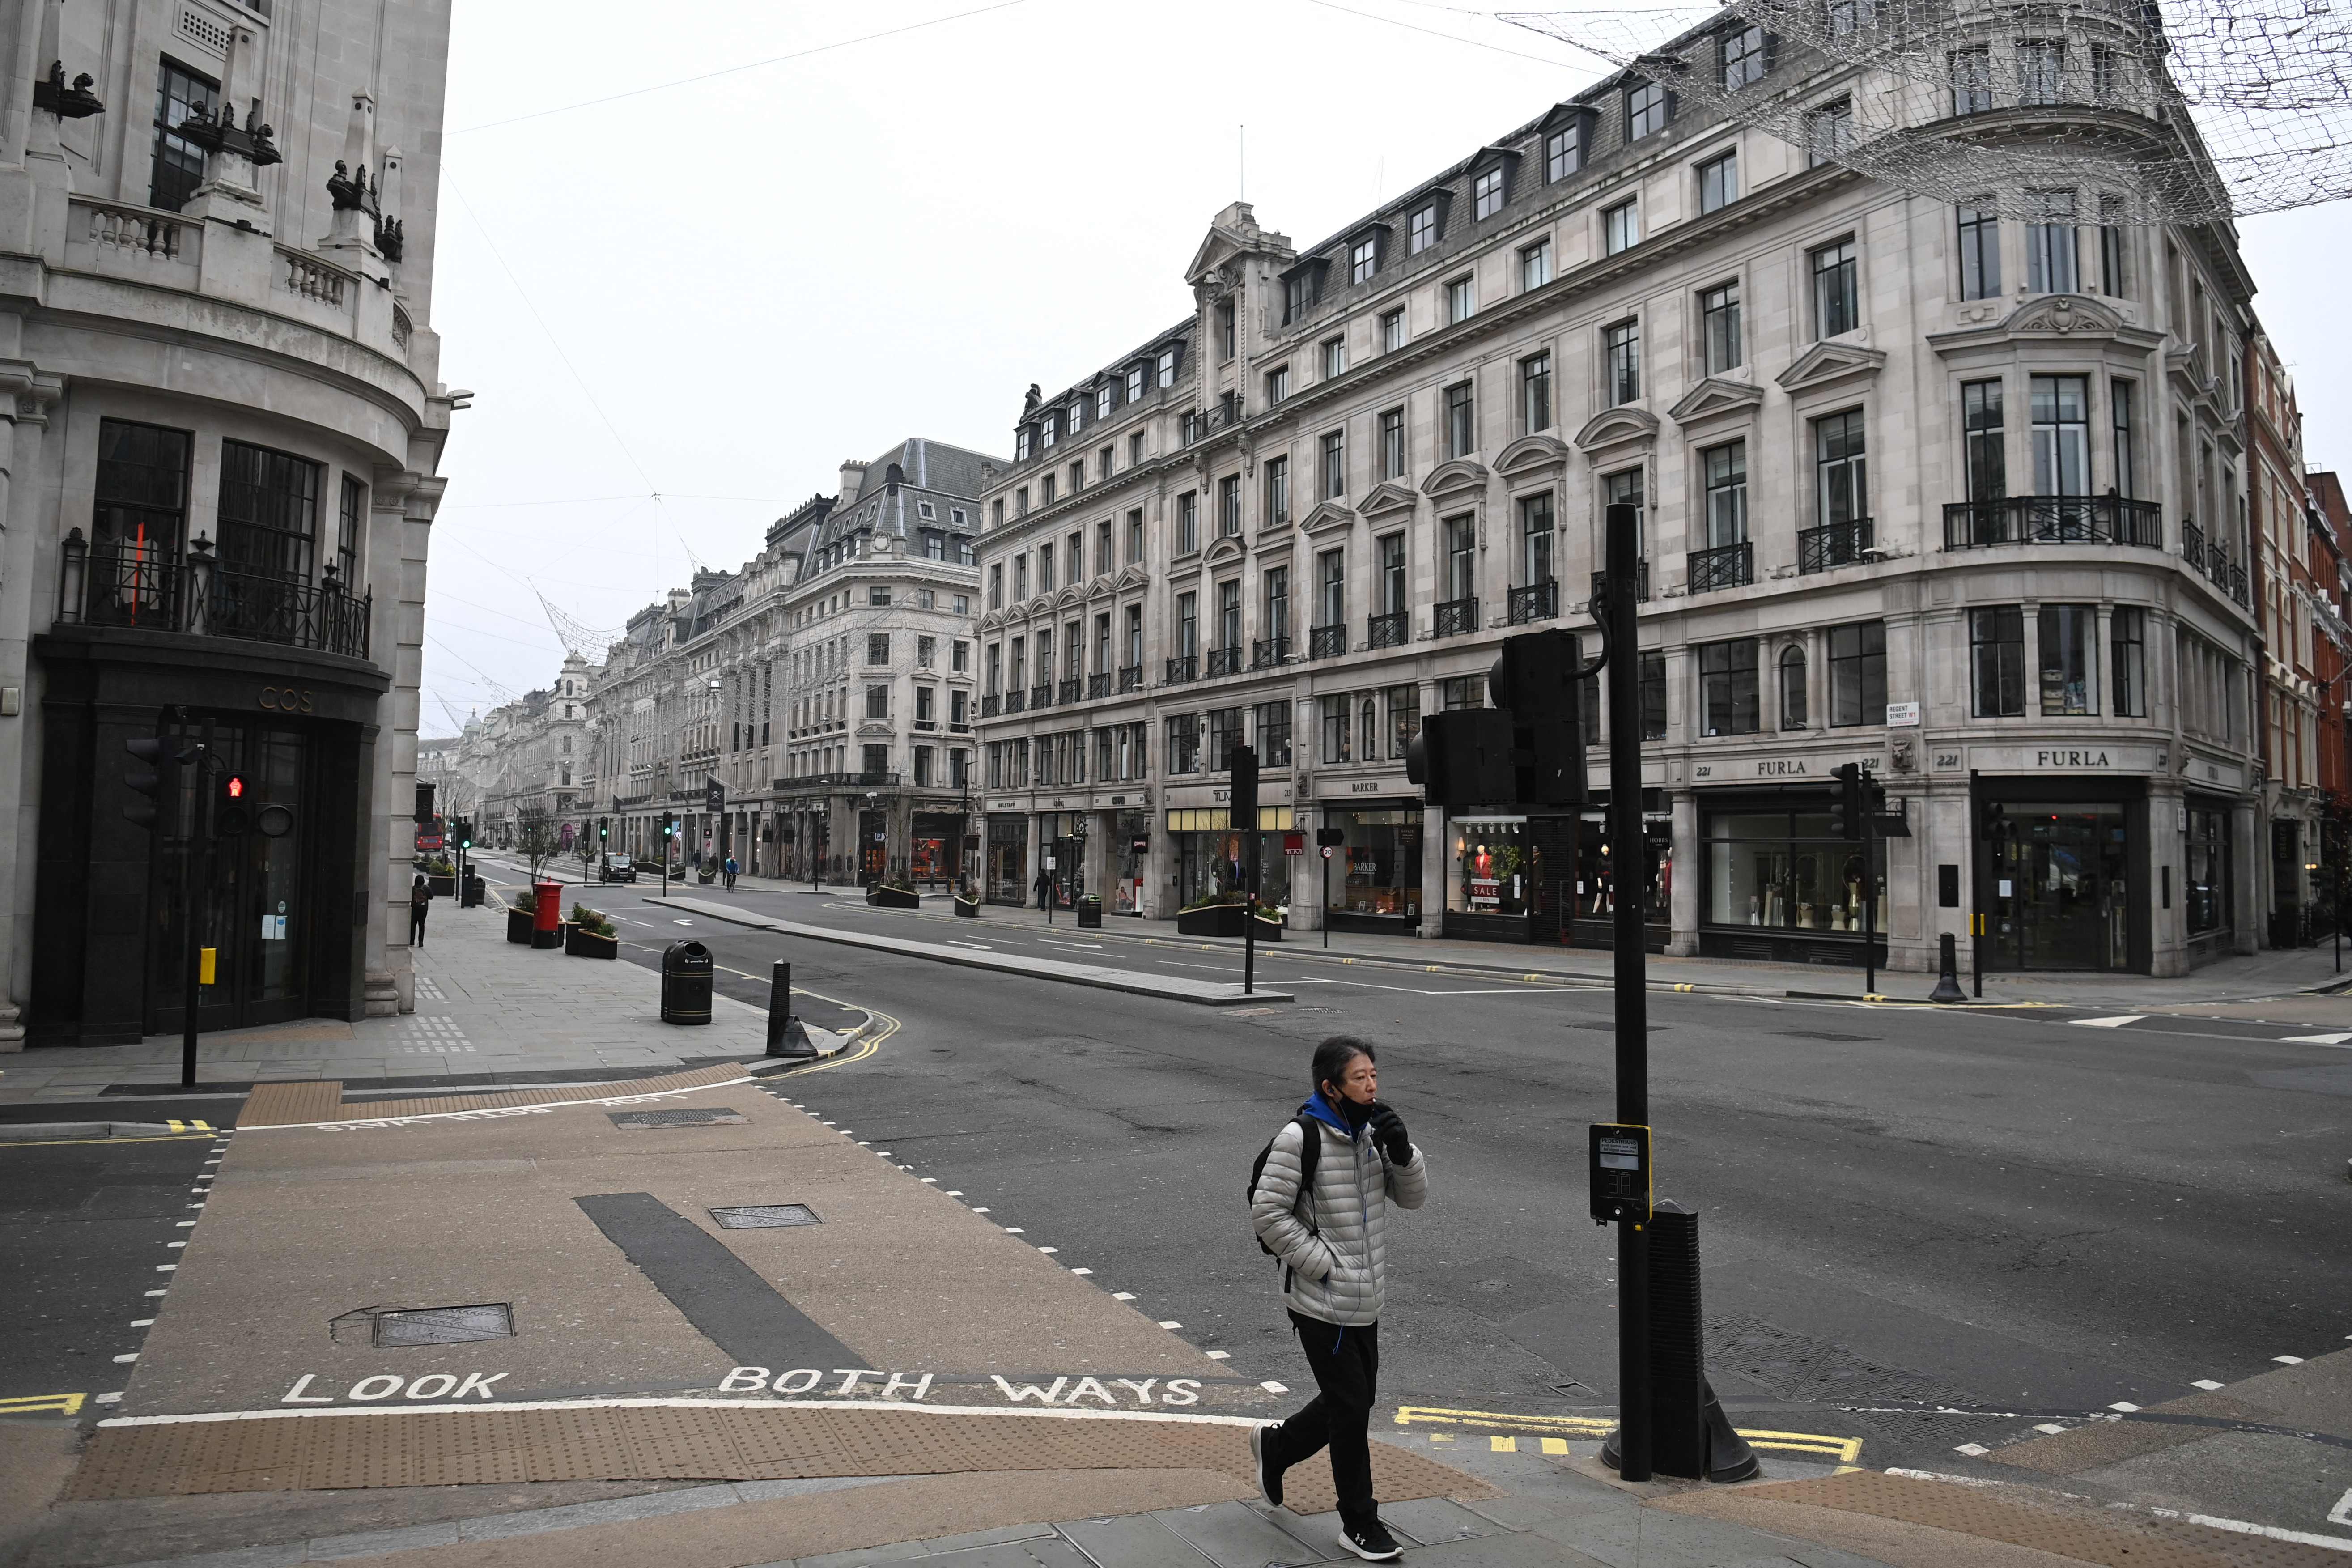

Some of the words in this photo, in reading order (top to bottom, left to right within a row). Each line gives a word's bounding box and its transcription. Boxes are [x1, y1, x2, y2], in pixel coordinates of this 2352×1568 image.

[259, 686, 313, 712] COS
[1864, 758, 1879, 769] 221
[1936, 755, 1957, 766] 221
[2037, 751, 2110, 766] FURLA
[1696, 766, 1711, 777] 221
[1758, 761, 1806, 775] FURLA
[1352, 782, 1378, 792] BARKER
[1213, 790, 1231, 802] TUM
[1353, 862, 1376, 871] BARKER
[1473, 886, 1498, 895] SALE
[281, 1372, 509, 1402] LOOK
[718, 1366, 934, 1399] BOTH
[990, 1375, 1202, 1405] WAYS
